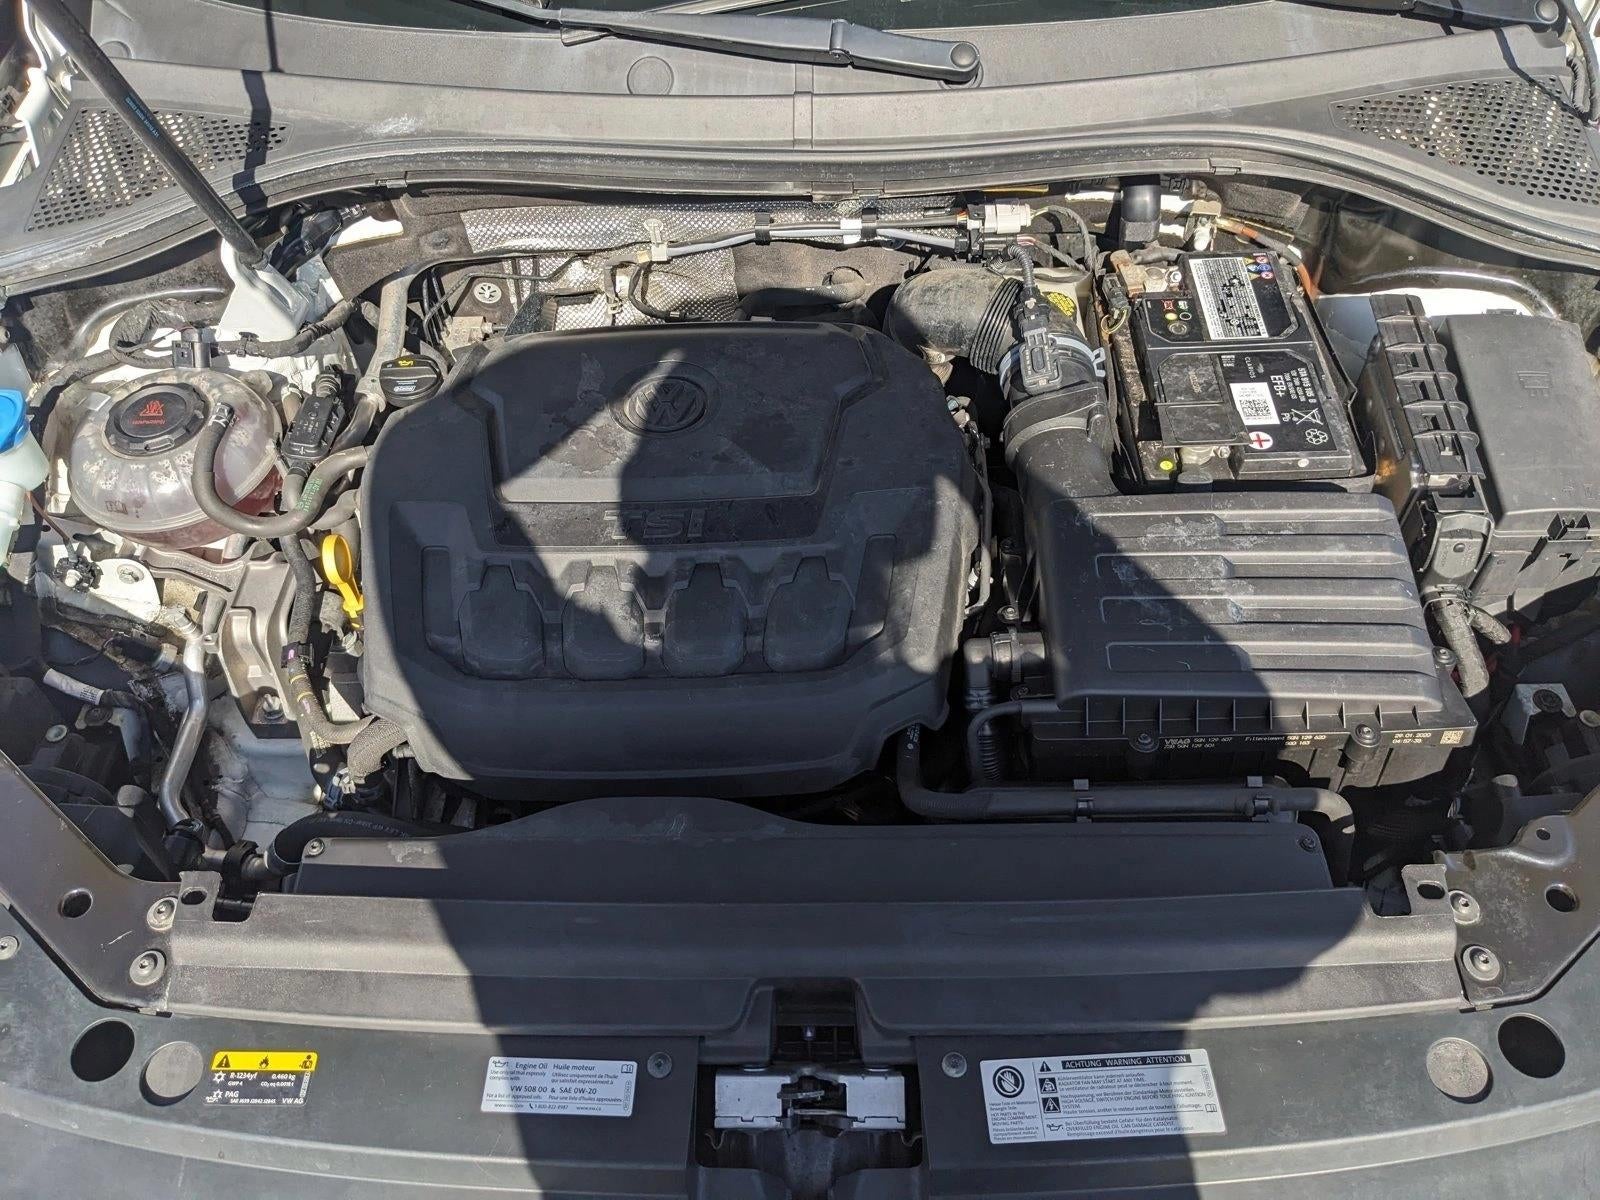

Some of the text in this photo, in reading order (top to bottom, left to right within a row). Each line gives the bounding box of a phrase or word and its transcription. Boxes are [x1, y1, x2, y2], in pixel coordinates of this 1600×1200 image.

[1244, 356, 1256, 378] CLARIOS
[1270, 375, 1287, 397] EFB+
[1281, 412, 1290, 421] Pb
[604, 509, 706, 540] TSI
[1065, 1055, 1186, 1068] ACHTUNG WARNING ATTENTION
[229, 1072, 258, 1080] R-1234yf
